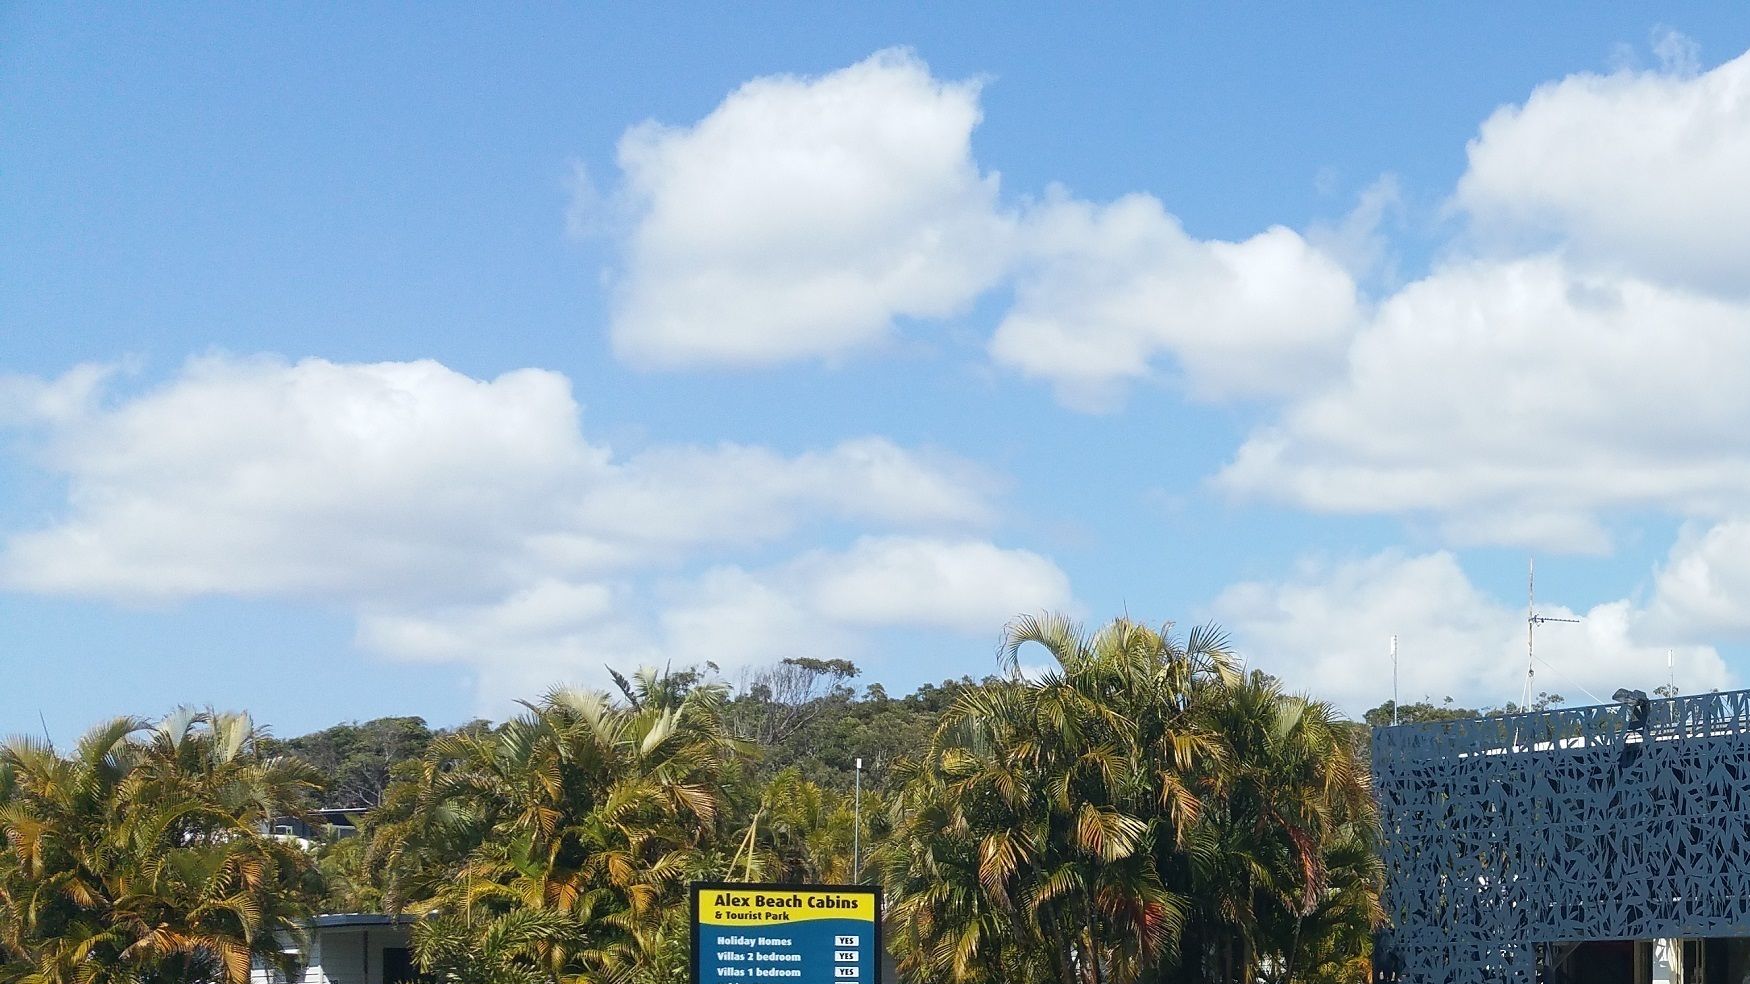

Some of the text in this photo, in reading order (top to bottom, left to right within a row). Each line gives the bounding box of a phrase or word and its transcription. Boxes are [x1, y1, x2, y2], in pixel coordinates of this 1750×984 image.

[715, 893, 858, 909] Alex Beach Cabins
[715, 911, 790, 920] & Tourist Park
[717, 936, 854, 947] Holiday Homes YES
[717, 952, 745, 961] Villas
[747, 953, 754, 961] 2
[756, 952, 801, 962] bedroom
[717, 967, 745, 977] Villas
[748, 968, 754, 976] 1
[756, 968, 801, 977] bedroom
